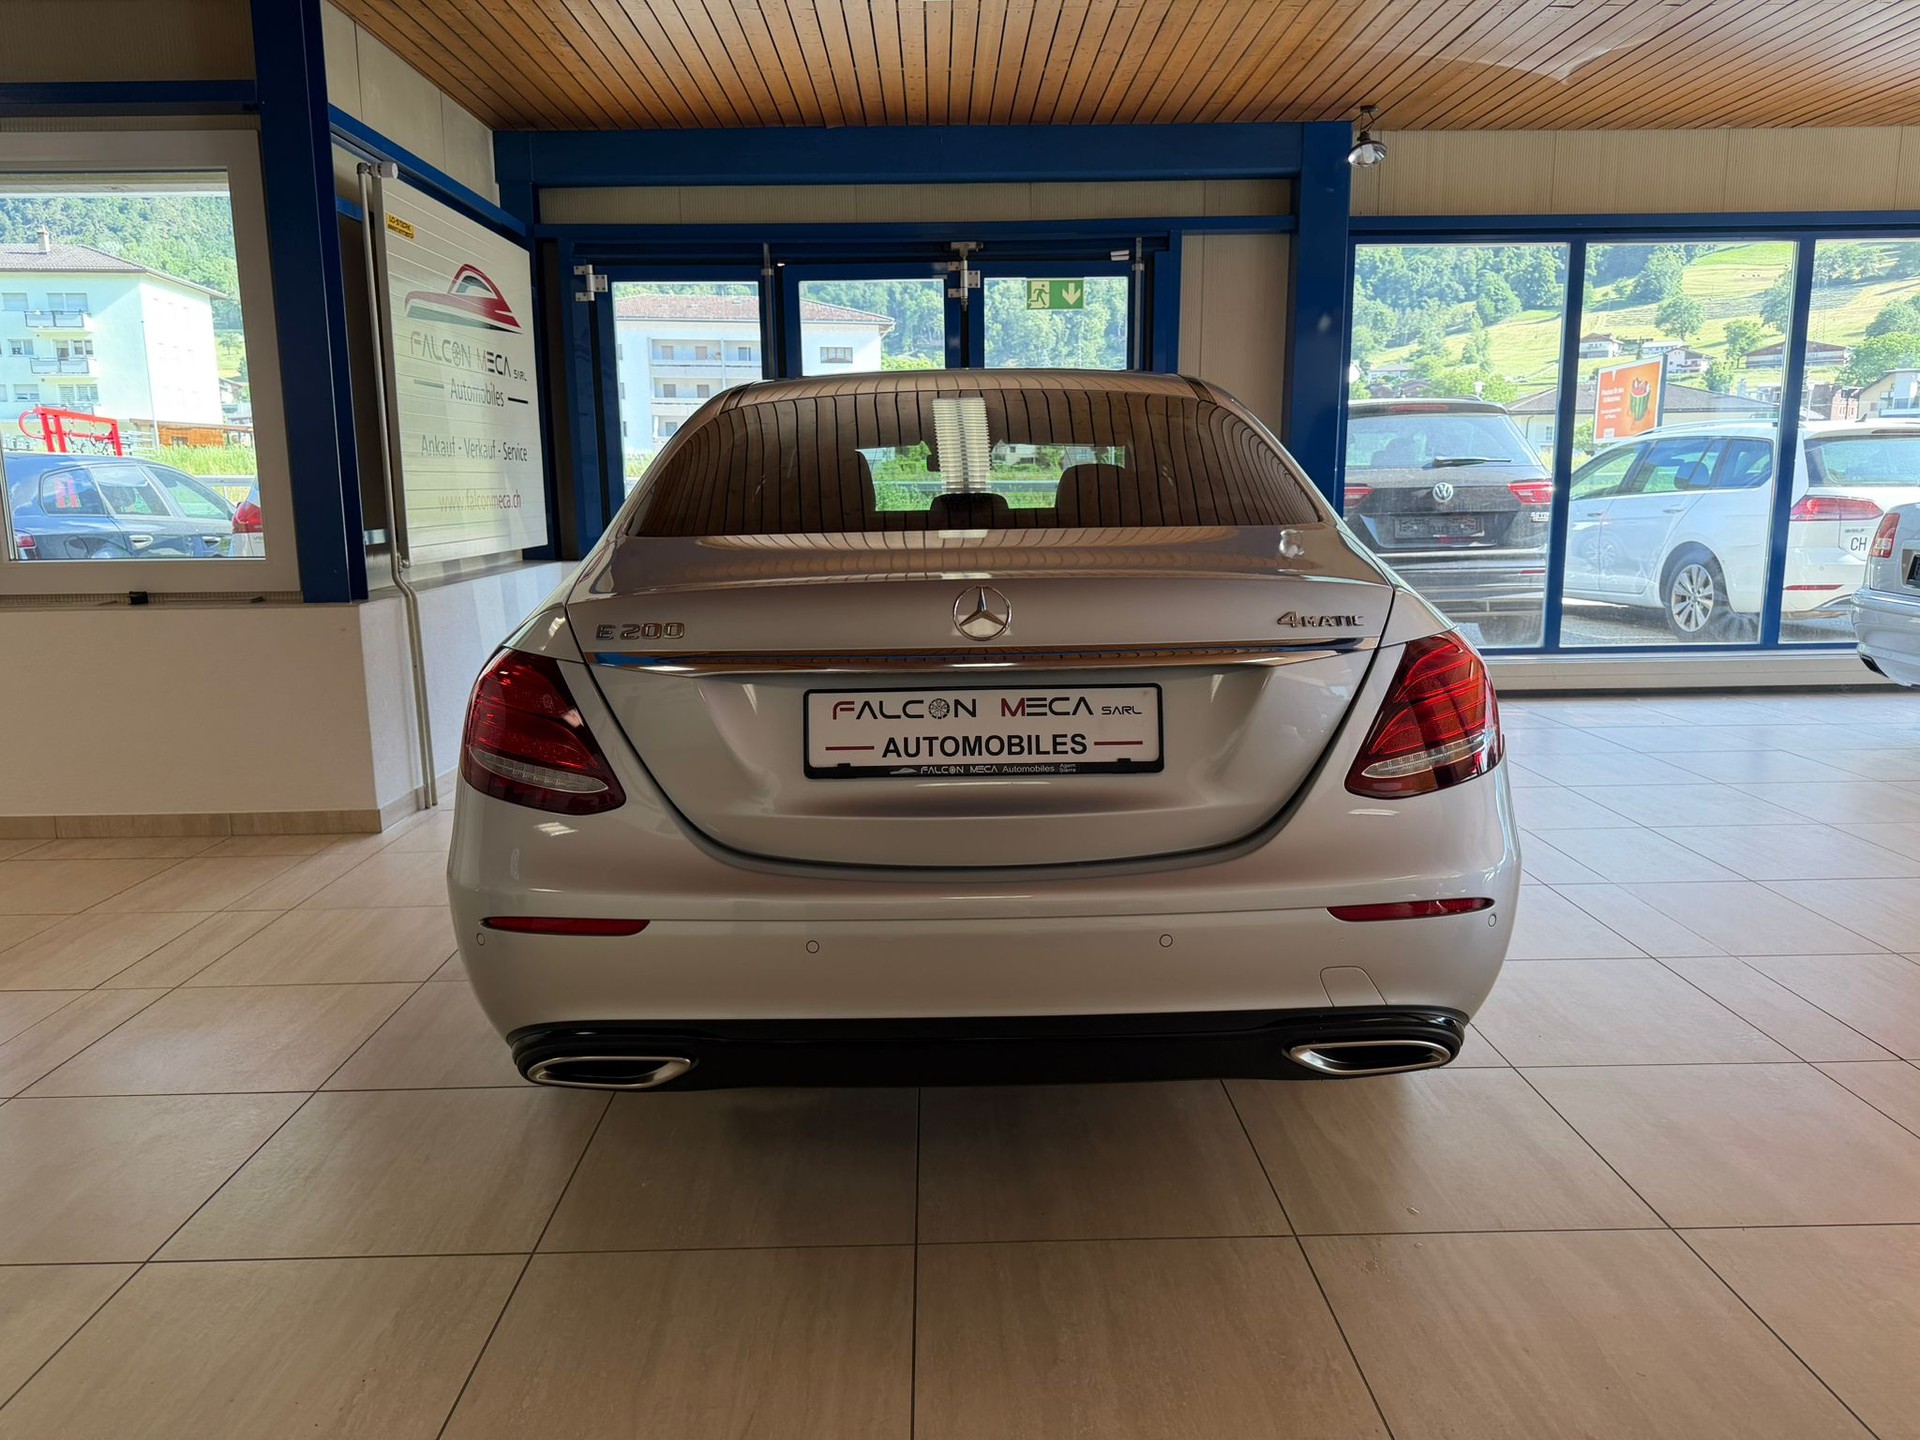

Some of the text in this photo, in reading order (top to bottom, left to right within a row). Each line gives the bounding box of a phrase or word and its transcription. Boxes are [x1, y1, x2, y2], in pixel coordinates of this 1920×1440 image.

[410, 331, 471, 368] FALCON
[477, 347, 511, 378] MECA
[450, 377, 505, 407] Automobiles
[421, 434, 456, 458] Ankauf
[463, 437, 496, 460] Verkauf
[502, 441, 528, 461] Service
[438, 489, 522, 512] www.falconmeca.ch
[1850, 537, 1868, 551] CH
[1276, 610, 1365, 627] 4MATIC
[832, 696, 1143, 720] FALCON MECA SARL
[881, 734, 1088, 759] AUTOMOBILES
[920, 764, 1055, 775] FALCON MECA Automobiles
